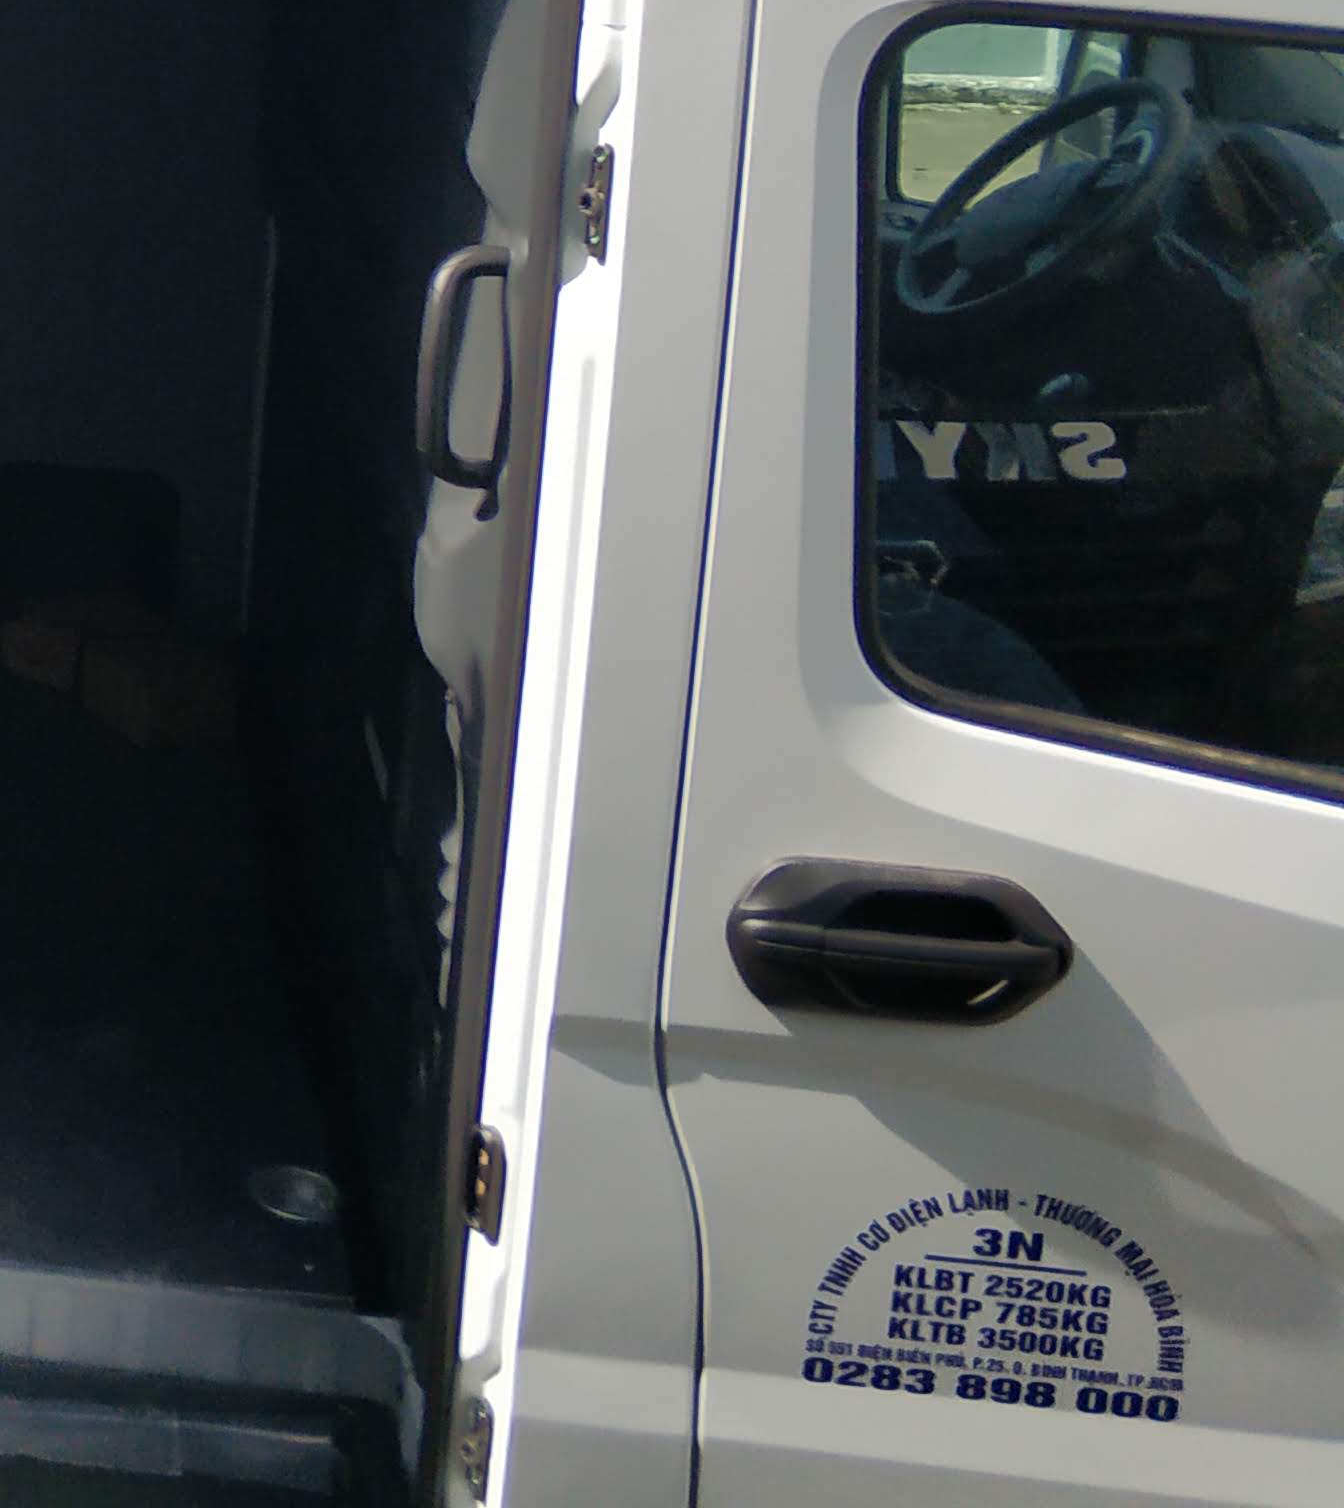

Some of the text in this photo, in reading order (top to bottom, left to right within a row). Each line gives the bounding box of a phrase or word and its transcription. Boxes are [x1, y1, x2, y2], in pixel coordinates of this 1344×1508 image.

[947, 1188, 1010, 1217] LẠNH
[973, 1227, 1045, 1262] 3N
[817, 1245, 867, 1296] TNHH
[893, 1264, 1112, 1309] KLBT 2520KG
[808, 1299, 838, 1335] CTY
[891, 1290, 1109, 1335] KLCP 785KG
[887, 1316, 1105, 1362] KLTB 3500KG
[802, 1356, 1180, 1423] 0283 898 000
